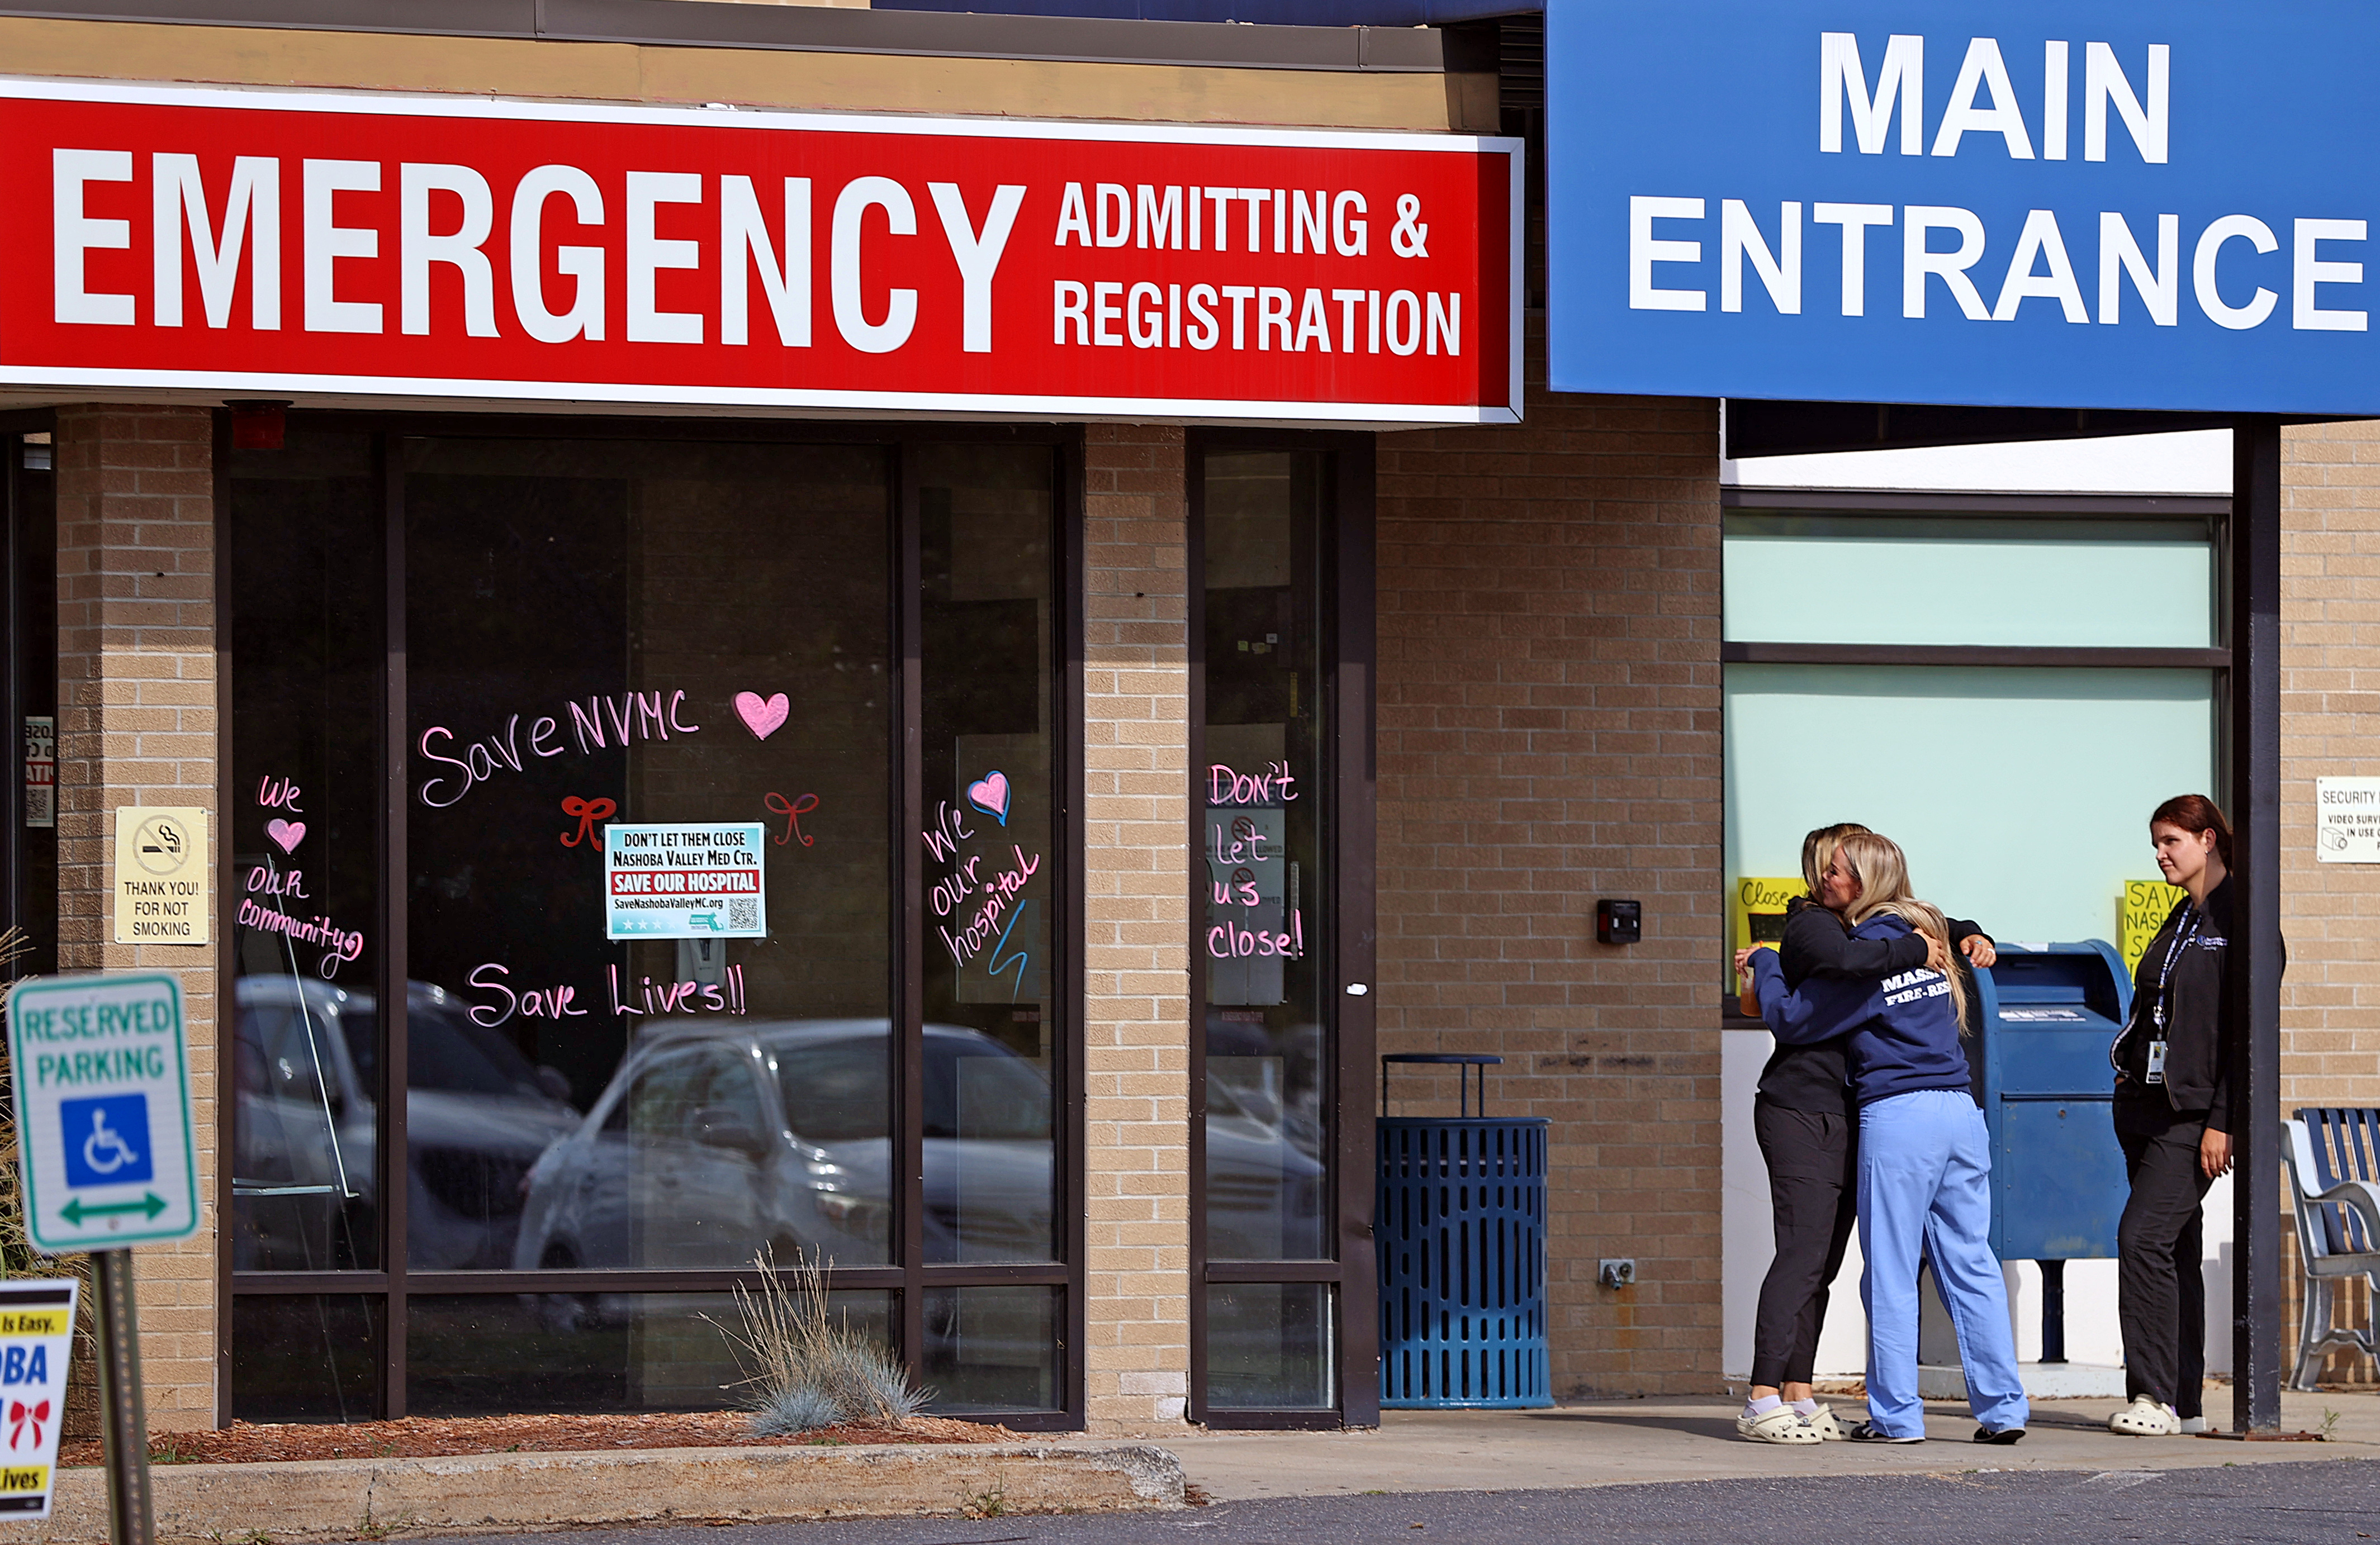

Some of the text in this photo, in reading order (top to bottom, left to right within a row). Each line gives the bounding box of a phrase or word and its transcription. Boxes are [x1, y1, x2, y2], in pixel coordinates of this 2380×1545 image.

[1820, 31, 2170, 164] MAIN
[1055, 182, 1429, 258] ADMITTING &
[53, 148, 1027, 354] EMERGENCY
[1629, 196, 2368, 331] ENTRANCE
[1054, 280, 1461, 356] REGISTRATION
[421, 689, 699, 807] Save NVMC
[260, 775, 303, 812] We
[2323, 790, 2375, 804] SECURITY
[922, 800, 975, 863] We
[2328, 814, 2354, 824] VIDEO
[2347, 828, 2355, 837] IN
[2358, 828, 2374, 837] USE
[624, 831, 746, 847] DON'T LET THEM CLOSE
[613, 850, 664, 867] NASHOBA
[666, 849, 704, 866] VALLEY
[124, 881, 199, 896] THANK YOU!
[614, 872, 757, 893] SAVE OUR HOSPITAL
[933, 855, 980, 916] our
[1214, 881, 1259, 906] us
[2130, 882, 2187, 910] SAV
[135, 901, 189, 916] FOR NOT
[614, 897, 723, 910] SaveNashobaValleyMC.org
[940, 844, 1040, 968] hospital
[132, 921, 191, 936] SMOKING
[470, 963, 746, 1027] Save Lives!!
[23, 999, 170, 1042] RESERVED
[37, 1044, 164, 1088] PARKING
[19, 1315, 55, 1333] Easy.
[0, 1345, 48, 1386] BA
